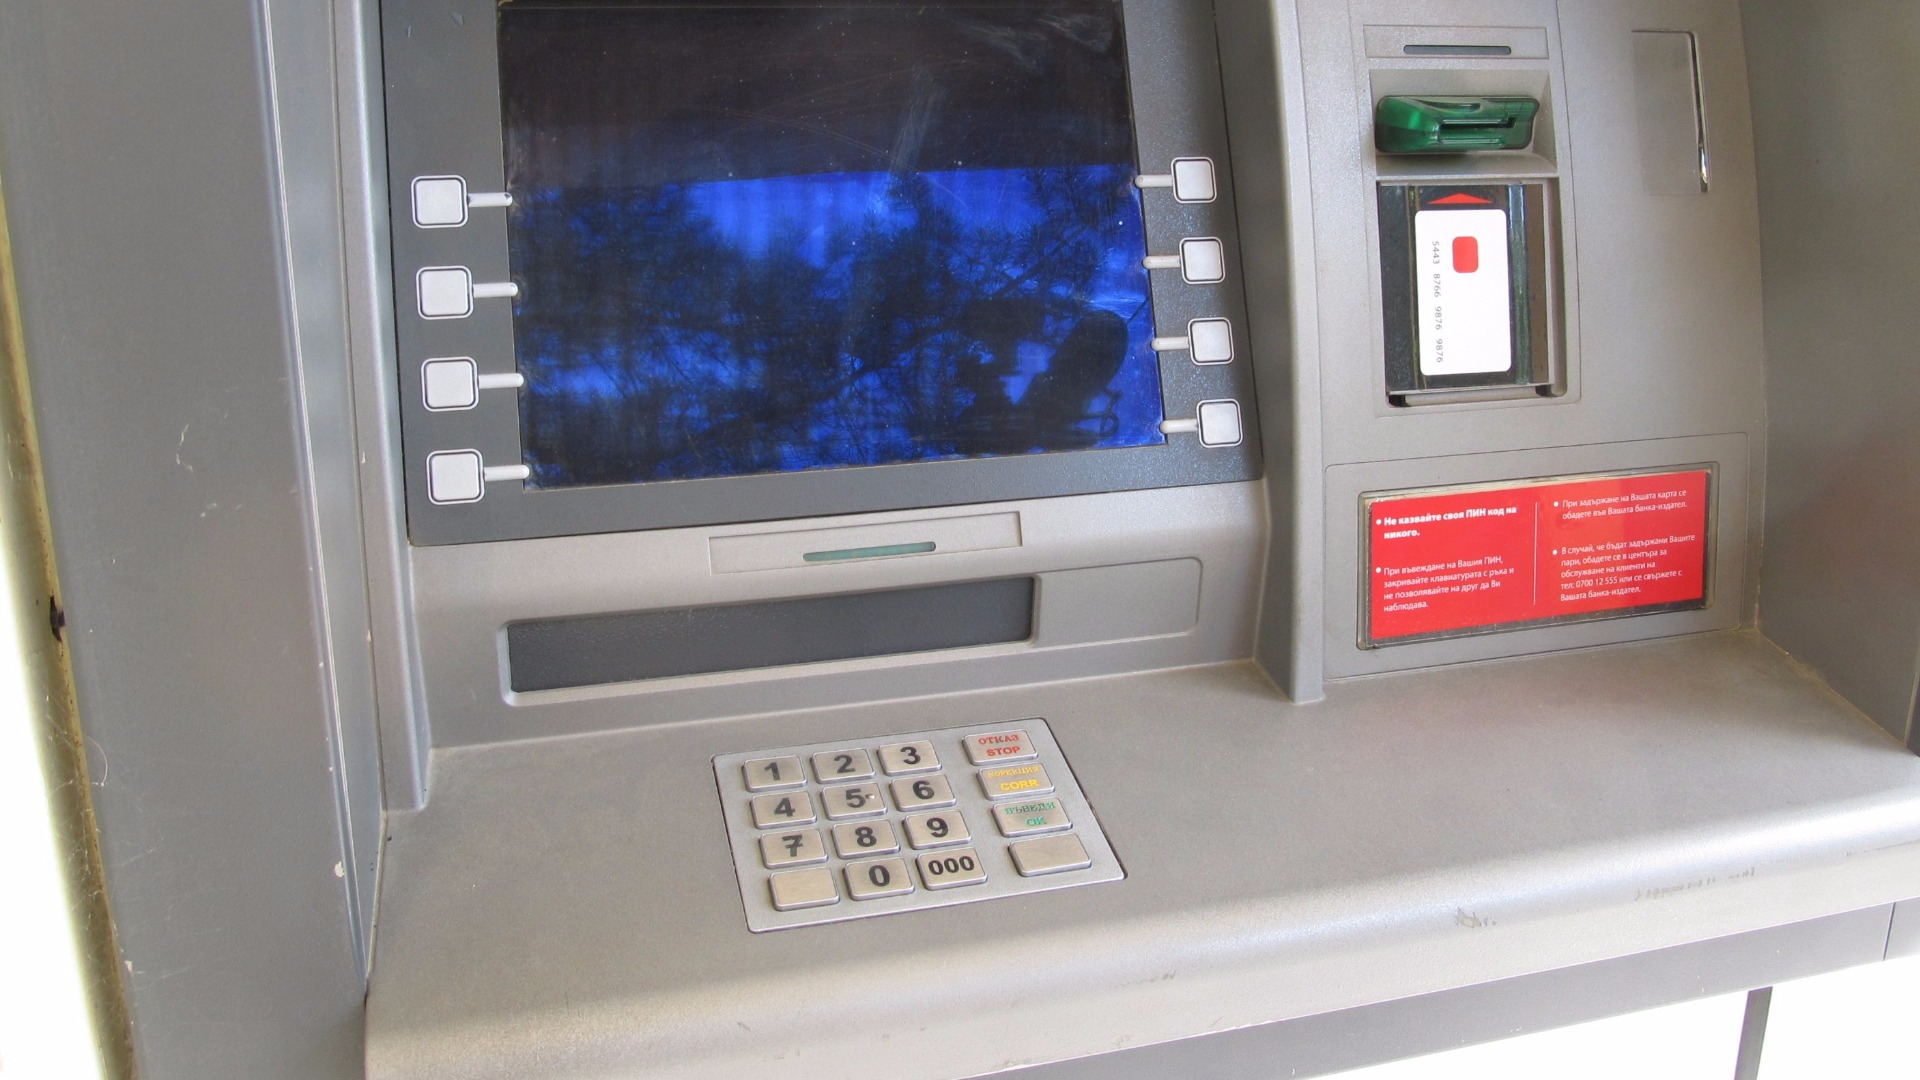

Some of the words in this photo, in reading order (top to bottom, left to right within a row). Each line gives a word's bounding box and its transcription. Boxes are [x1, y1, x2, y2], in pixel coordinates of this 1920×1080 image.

[1431, 241, 1440, 265] 5443
[1433, 273, 1441, 297] 8766
[1434, 306, 1443, 330] 9876
[1435, 338, 1443, 363] 9876
[1563, 499, 1577, 509] При
[1579, 497, 1618, 507] задържане
[1631, 492, 1656, 501] Вашата
[1658, 490, 1677, 500] карта
[1384, 517, 1396, 526] Не
[1399, 514, 1441, 525] казвайте
[1443, 511, 1464, 520] своя
[1466, 508, 1486, 518] ПИН
[1488, 508, 1504, 516] код
[1562, 511, 1592, 519] обадете
[1608, 506, 1633, 515] Вашата
[1384, 529, 1420, 539] никого.
[1607, 540, 1627, 550] бъдат
[1629, 538, 1668, 549] задържани
[1669, 534, 1695, 544] Вашите
[1384, 567, 1399, 577] При
[1402, 563, 1445, 573] въвеждане
[1458, 559, 1482, 568] Вашия
[1484, 556, 1503, 564] ПИН,
[1561, 558, 1581, 567] пари,
[1583, 555, 1611, 564] обадете
[1628, 550, 1658, 559] центъра
[1384, 577, 1428, 588] закривайте
[1431, 571, 1482, 583] клавиатурата
[1489, 568, 1507, 577] ръка
[1561, 567, 1604, 578] обслужване
[1616, 563, 1645, 572] клиенти
[1576, 578, 1593, 588] 0700
[1605, 576, 1617, 584] 555
[1644, 570, 1676, 581] свържете
[1395, 586, 1449, 598] позволявайте
[1461, 582, 1478, 592] друг
[1480, 582, 1490, 590] да
[1561, 592, 1586, 601] Вашата
[1384, 601, 1428, 612] наблюдава.
[978, 734, 1019, 745] ОТКАЗ
[900, 746, 921, 764] 3
[986, 746, 1020, 756] STOP
[764, 762, 780, 781] 1
[834, 754, 855, 774] 2
[912, 780, 935, 800] 6
[1000, 779, 1039, 791] CORR
[774, 797, 795, 817] 4
[845, 788, 866, 809] 5
[855, 826, 877, 848] 8
[926, 817, 948, 838] 9
[782, 834, 803, 857] 7
[928, 855, 975, 876] 000
[869, 865, 890, 887] 0
